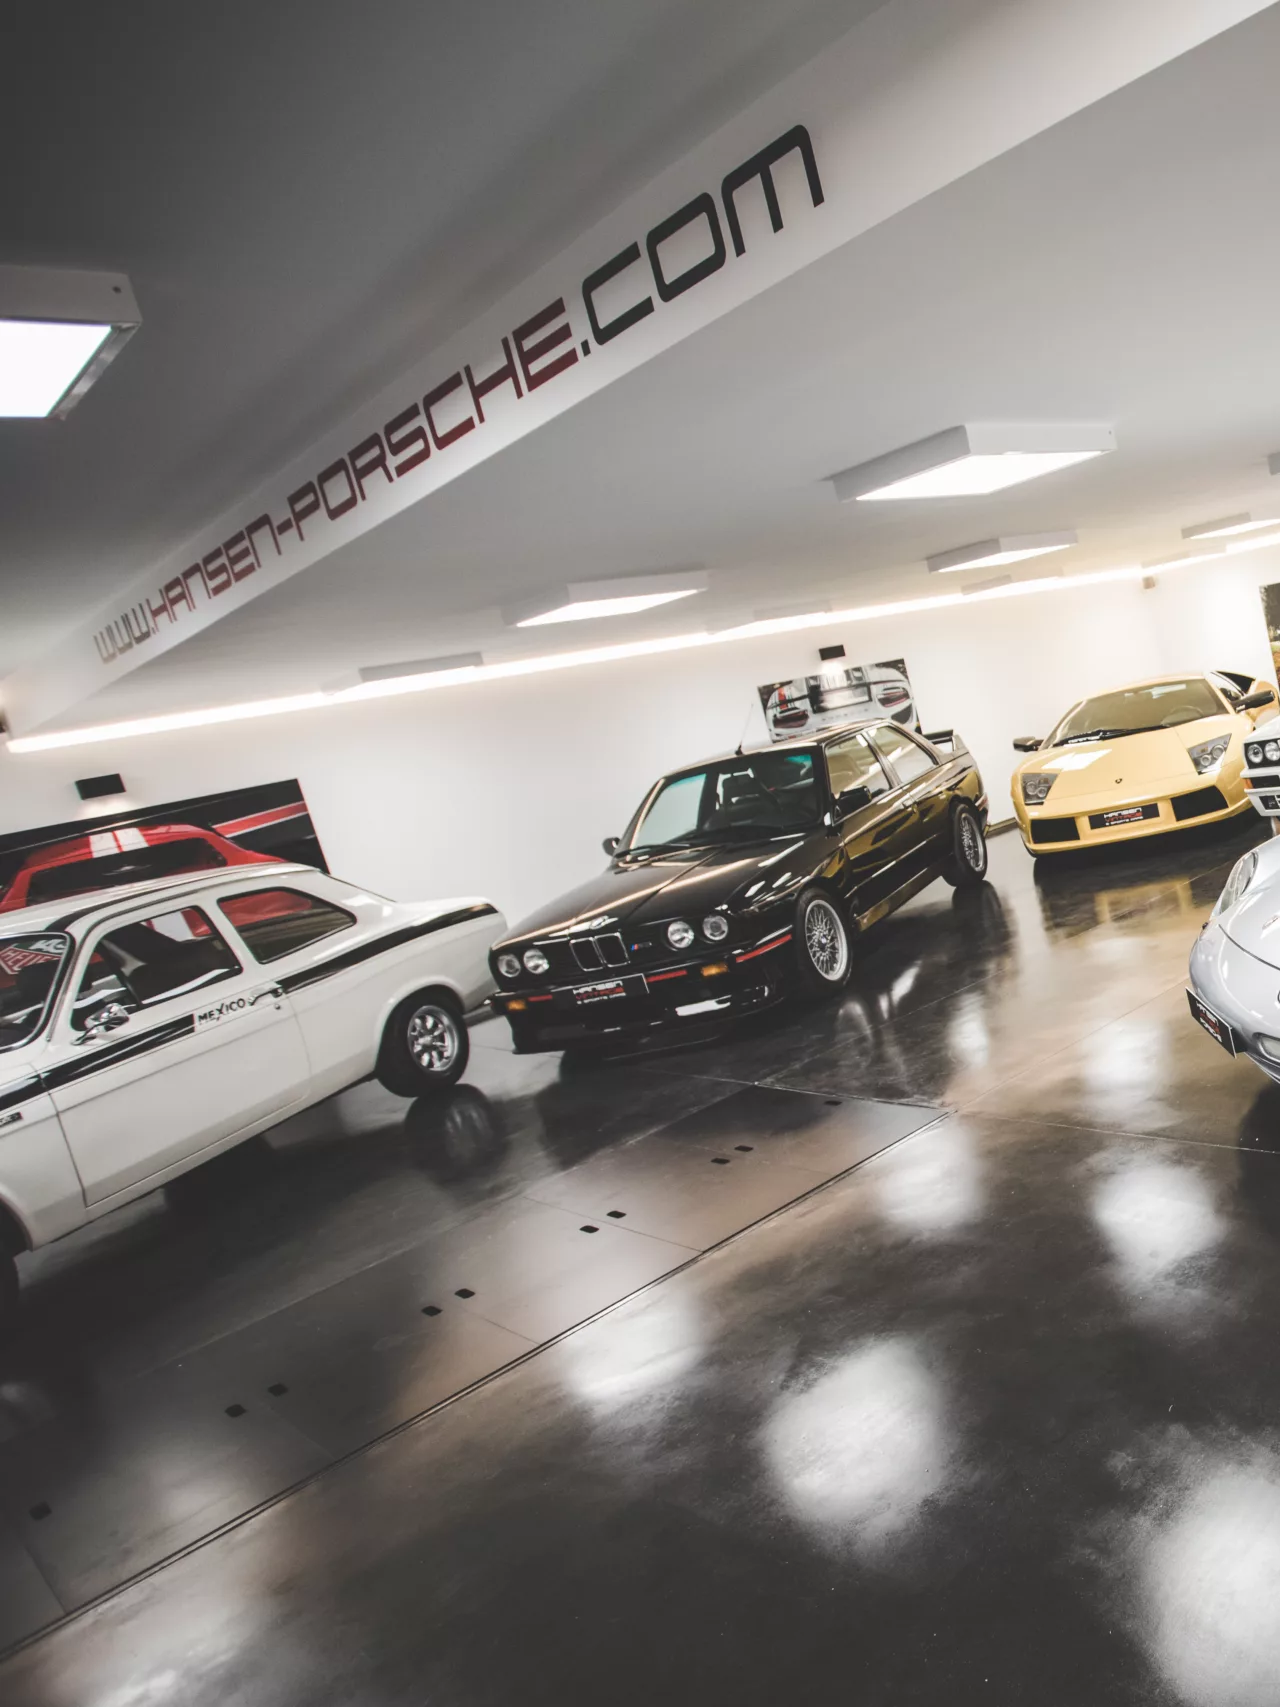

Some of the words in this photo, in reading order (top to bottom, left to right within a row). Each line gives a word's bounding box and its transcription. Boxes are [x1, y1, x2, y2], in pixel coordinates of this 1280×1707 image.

[1103, 807, 1142, 819] HANSEN
[572, 980, 623, 995] HANSEN
[198, 998, 246, 1022] MEXICO
